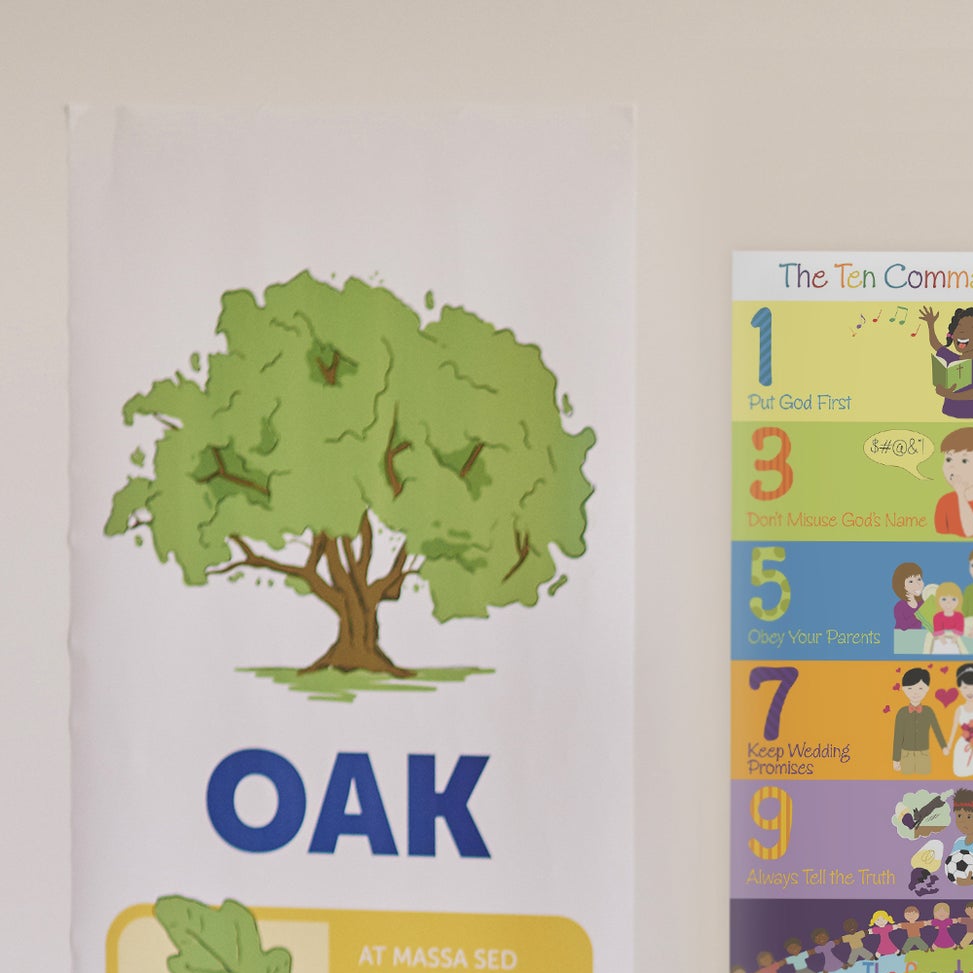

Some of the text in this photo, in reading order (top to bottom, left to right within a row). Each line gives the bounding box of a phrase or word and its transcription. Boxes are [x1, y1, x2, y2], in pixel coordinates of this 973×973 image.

[779, 263, 828, 288] The
[834, 263, 876, 288] Ten
[751, 307, 772, 387] 1
[748, 393, 852, 411] Put God First
[750, 427, 793, 501] 3
[747, 512, 927, 528] Don't Misuse God's Name
[749, 546, 791, 621] 5
[748, 628, 881, 649] Obey Your Parents
[749, 666, 799, 740] 7
[748, 741, 851, 763] Keep Wedding
[747, 759, 814, 776] Promises
[206, 748, 491, 859] OAK
[748, 785, 793, 860] 9
[745, 868, 896, 889] Always Tell the Truth
[359, 945, 518, 970] AT MASSA SED
